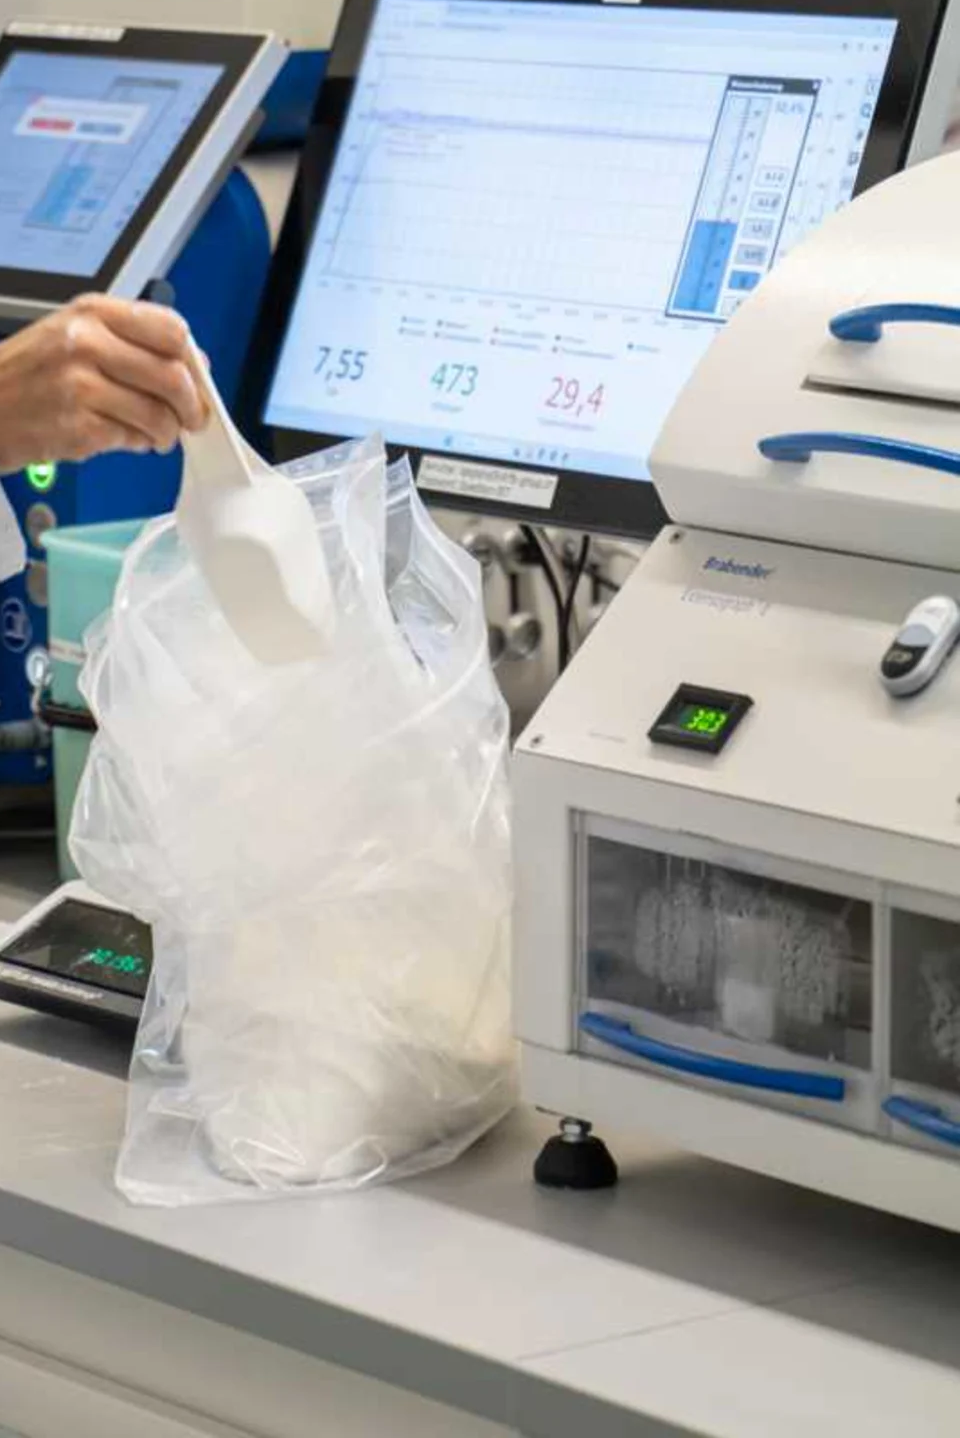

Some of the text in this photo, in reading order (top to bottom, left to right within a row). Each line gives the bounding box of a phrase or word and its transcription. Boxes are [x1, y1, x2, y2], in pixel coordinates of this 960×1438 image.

[313, 346, 368, 382] 7,55
[430, 363, 479, 396] 473
[545, 376, 605, 416] 29,4
[702, 555, 775, 579] Brabender
